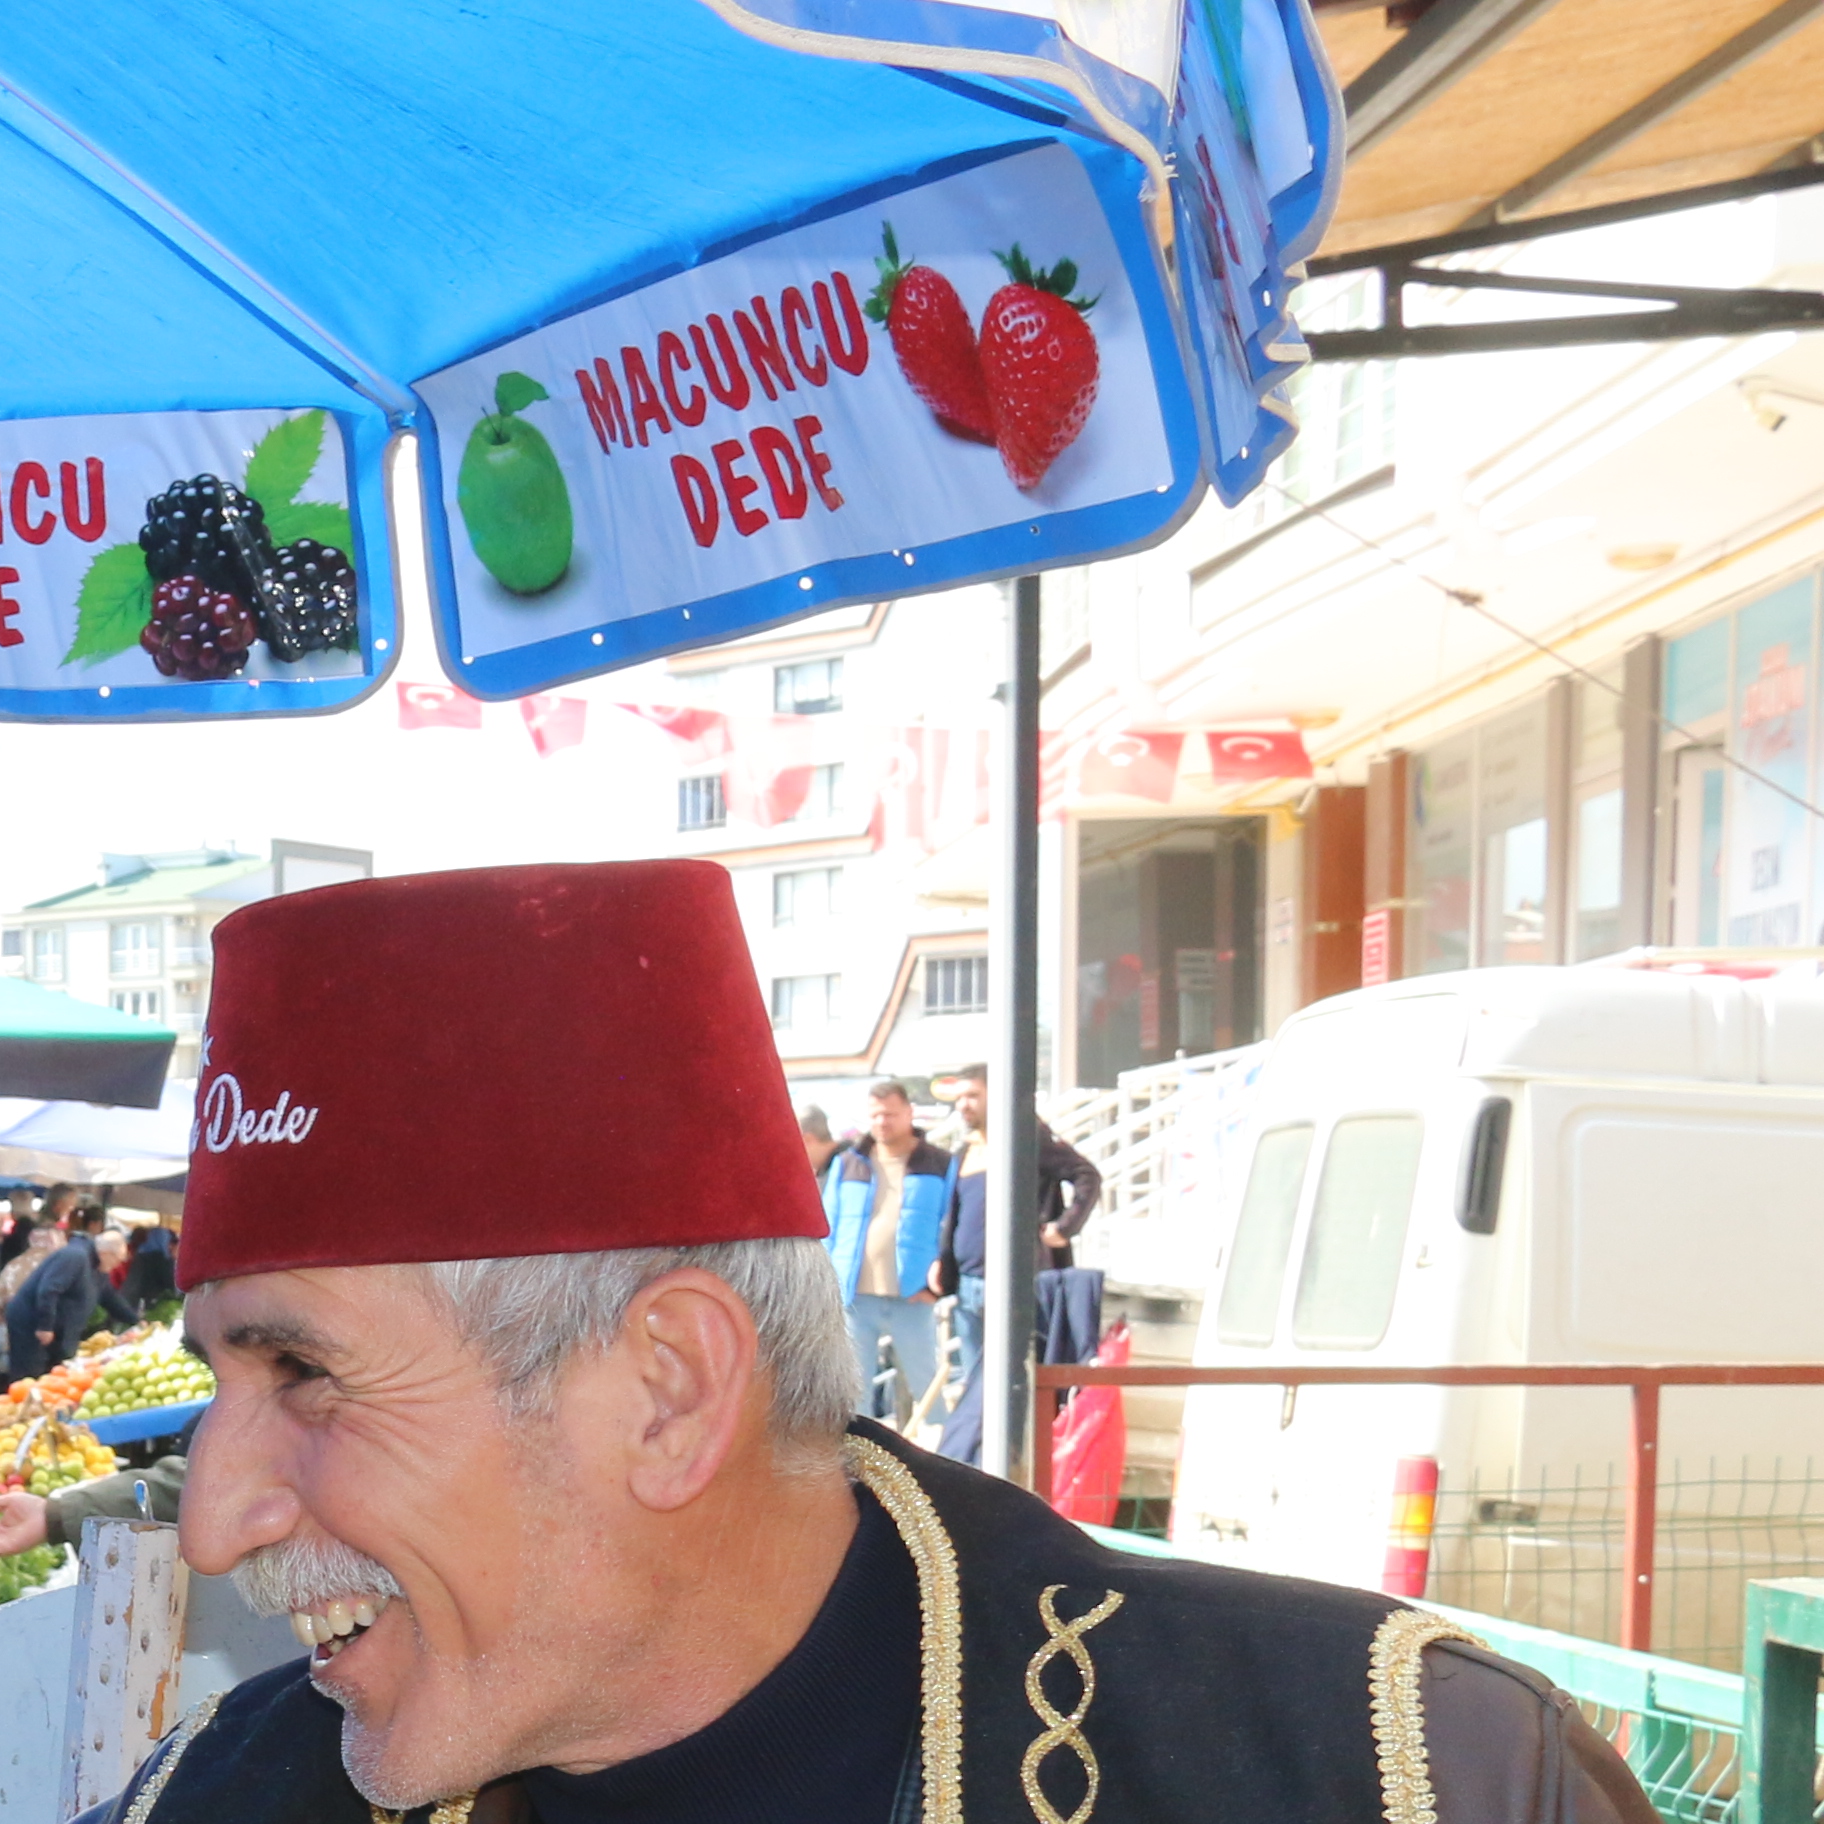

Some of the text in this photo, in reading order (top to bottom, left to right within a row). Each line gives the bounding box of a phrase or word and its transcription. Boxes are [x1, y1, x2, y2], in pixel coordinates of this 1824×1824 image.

[574, 271, 870, 456] MACUNCU
[670, 415, 845, 548] DEDE
[202, 1072, 320, 1155] Dede
